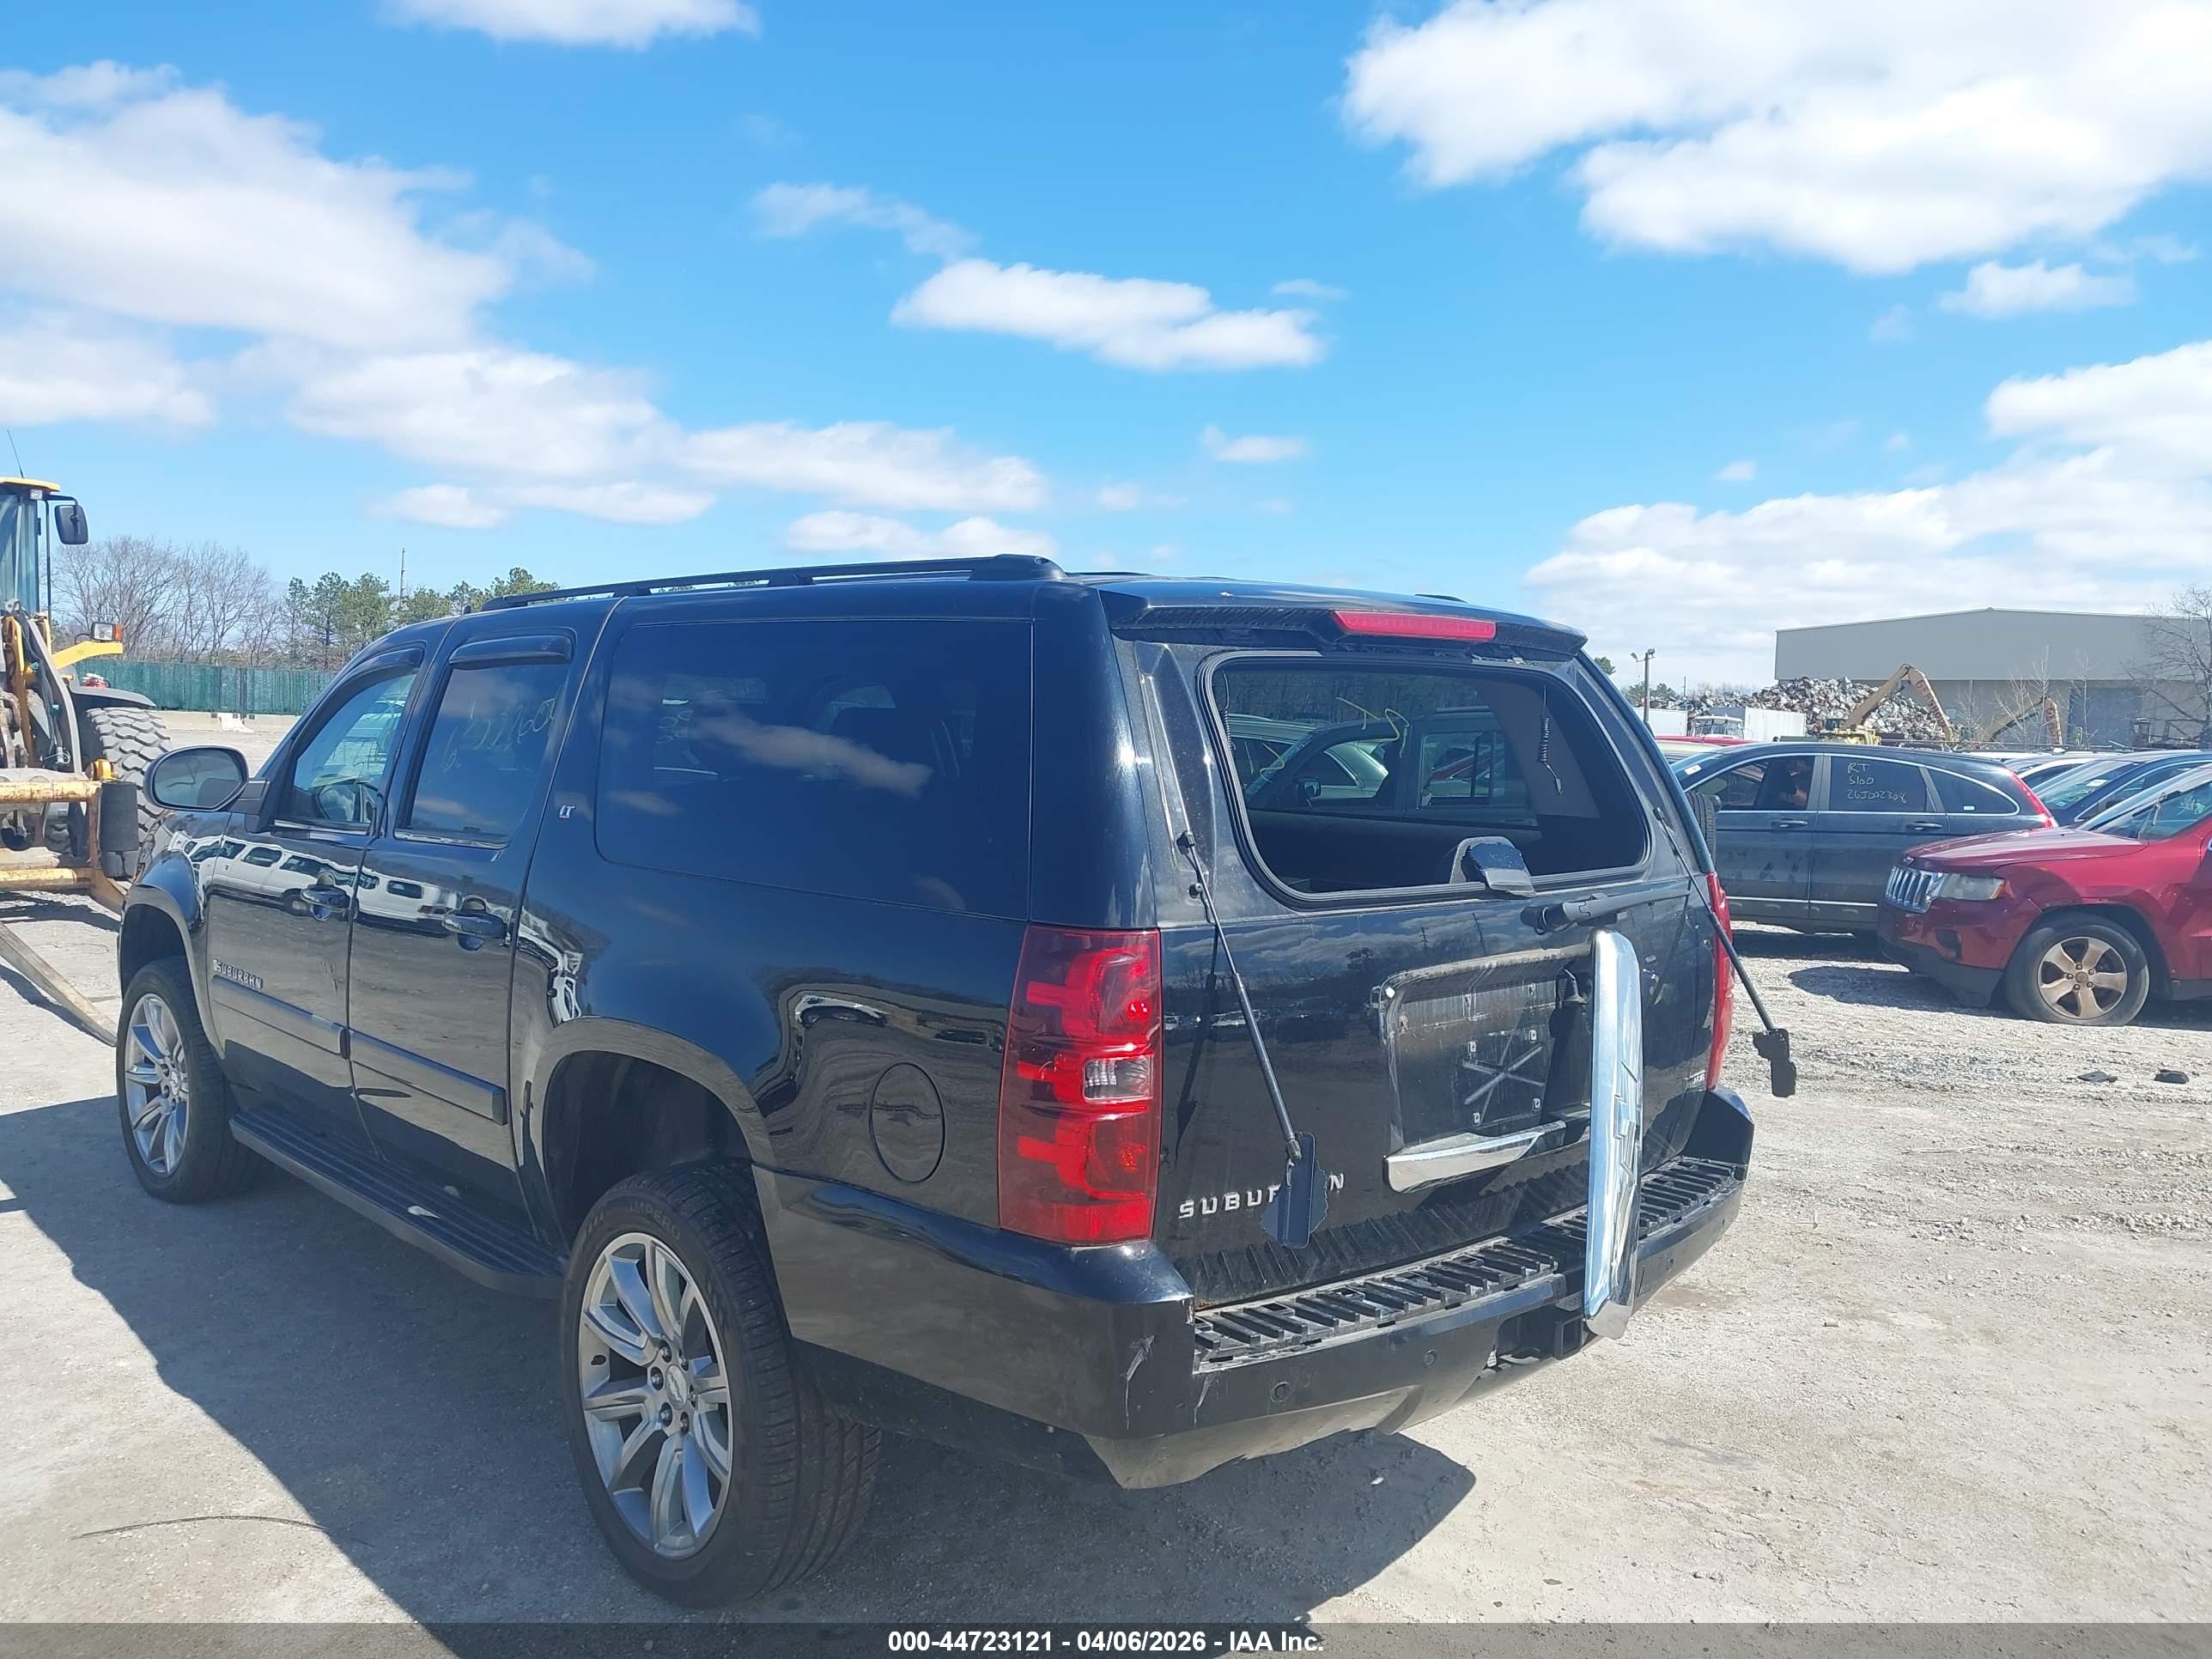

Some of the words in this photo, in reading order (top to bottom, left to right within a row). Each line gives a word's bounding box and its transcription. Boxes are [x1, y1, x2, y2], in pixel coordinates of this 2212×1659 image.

[1847, 762, 1870, 774] RT
[558, 805, 576, 819] LT
[212, 957, 264, 990] SUBURBAN
[629, 1200, 681, 1241] IMPERO
